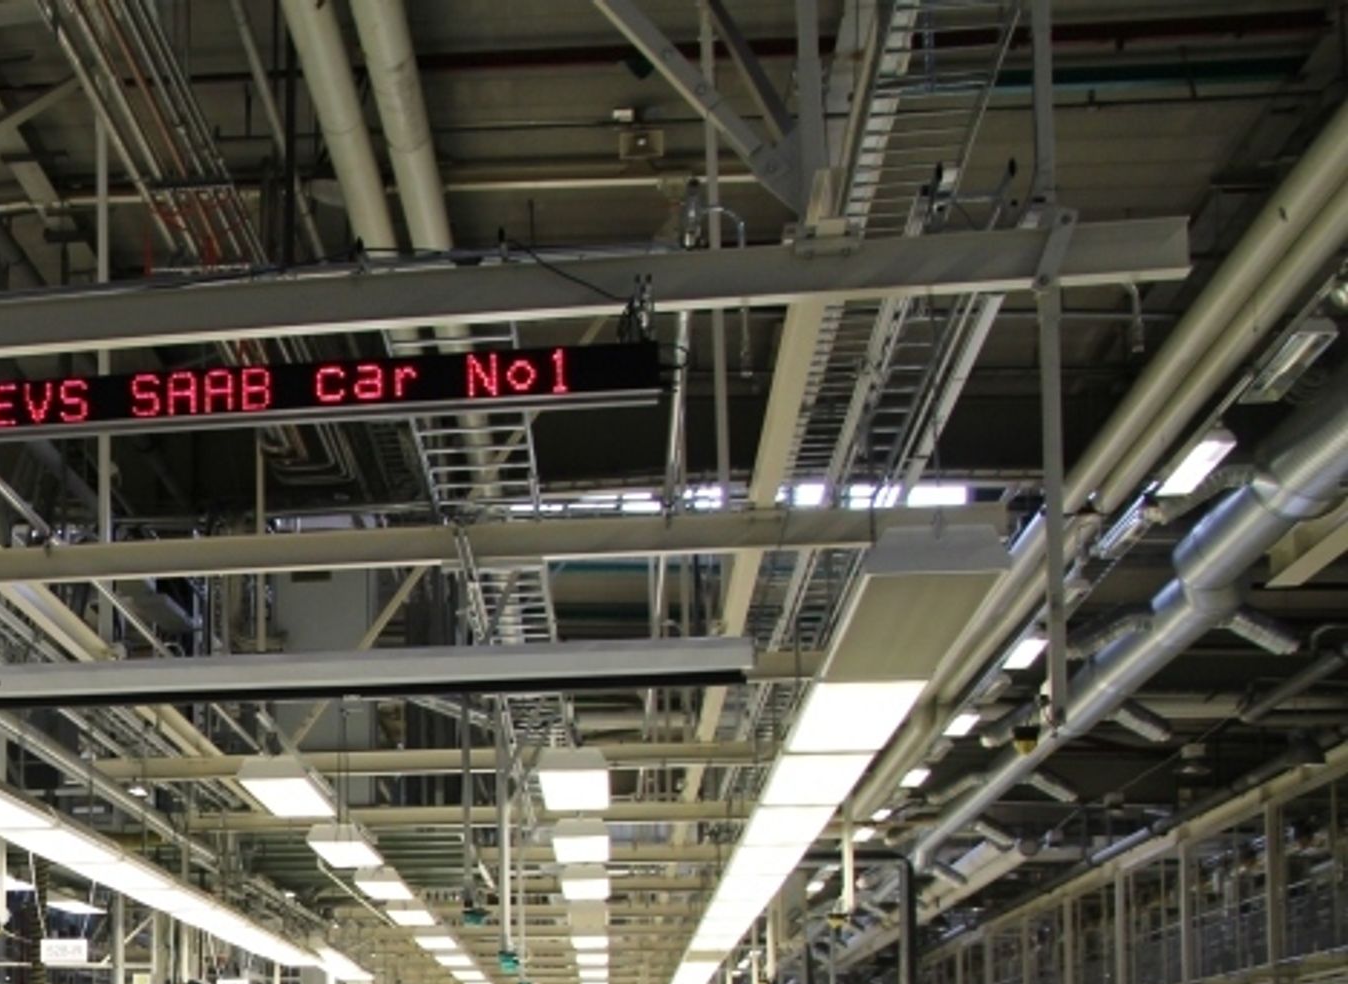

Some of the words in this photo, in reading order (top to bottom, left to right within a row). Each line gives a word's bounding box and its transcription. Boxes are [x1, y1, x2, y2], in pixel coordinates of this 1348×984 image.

[131, 367, 271, 416] SAAB
[315, 364, 417, 402] car
[466, 348, 568, 398] No1
